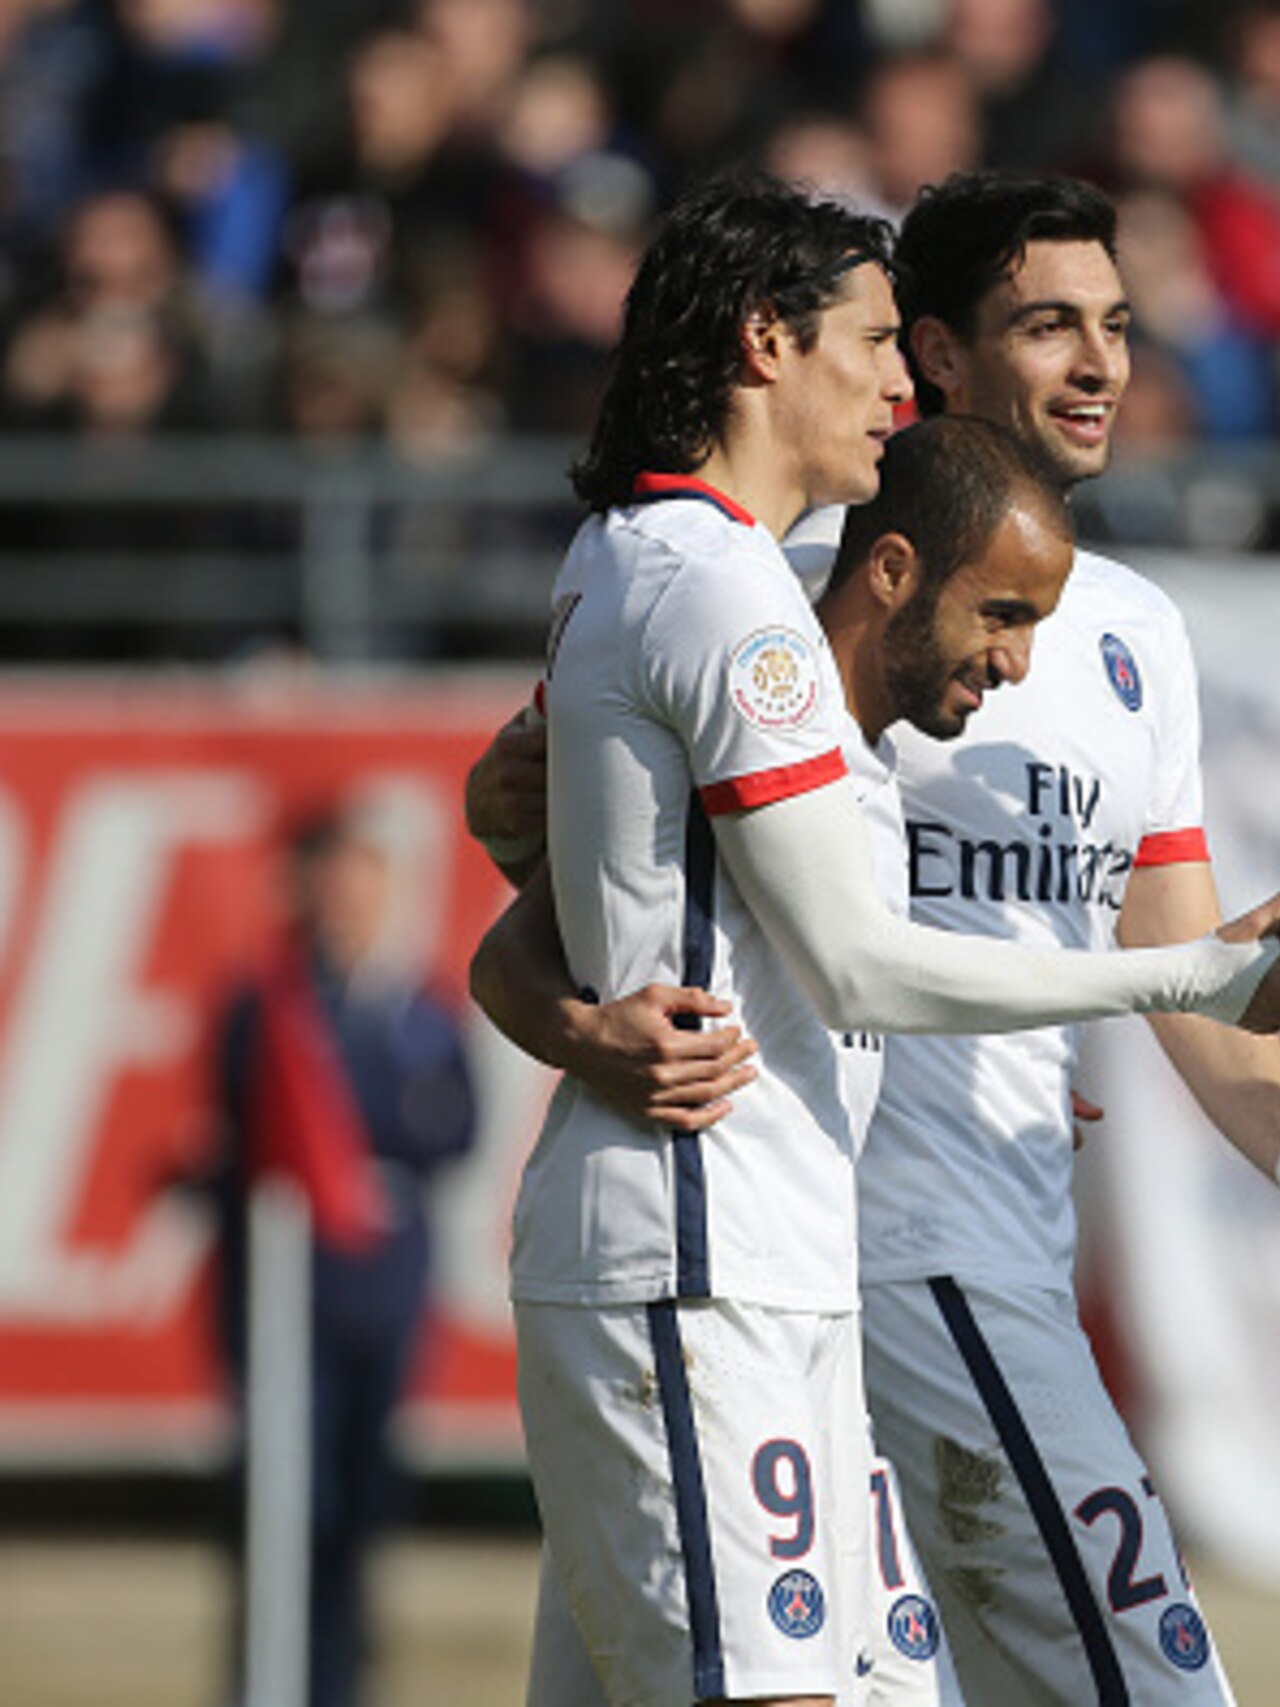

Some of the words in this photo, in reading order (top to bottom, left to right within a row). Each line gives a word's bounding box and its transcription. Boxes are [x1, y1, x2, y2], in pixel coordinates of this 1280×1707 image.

[1025, 762, 1101, 828] Fly
[905, 820, 1134, 909] Emirate
[751, 1438, 815, 1562] 9
[1073, 1475, 1196, 1614] 2
